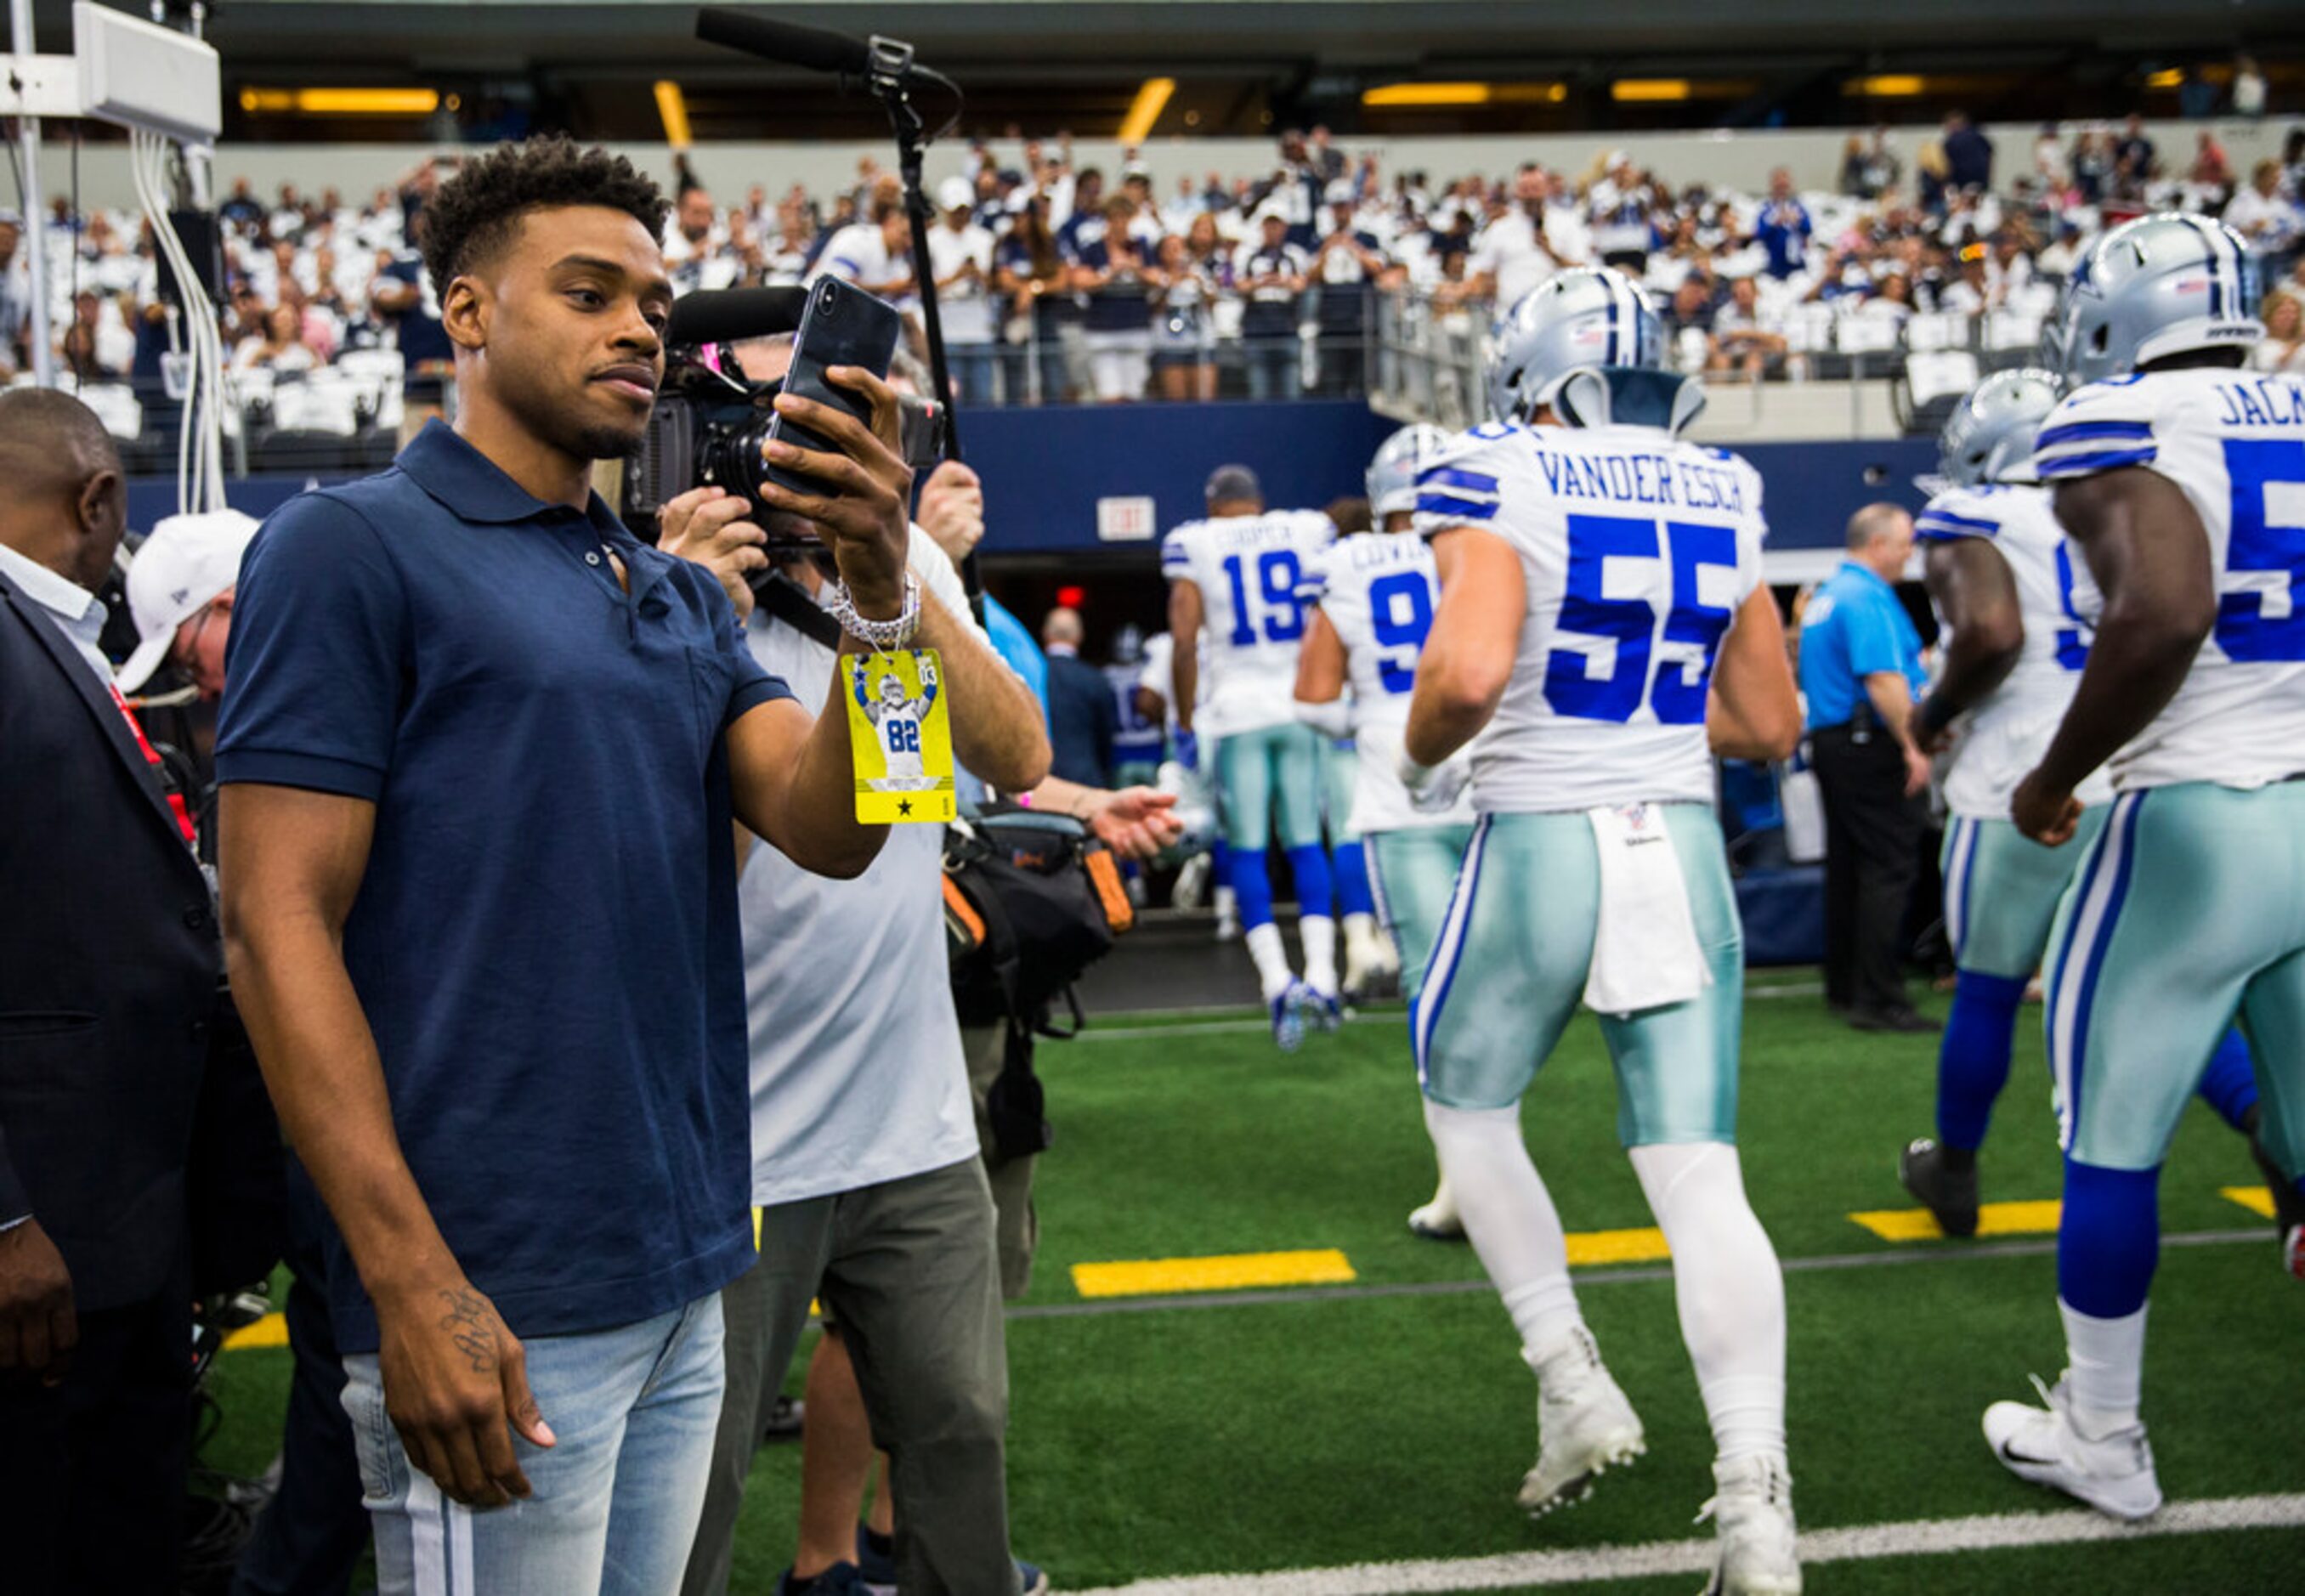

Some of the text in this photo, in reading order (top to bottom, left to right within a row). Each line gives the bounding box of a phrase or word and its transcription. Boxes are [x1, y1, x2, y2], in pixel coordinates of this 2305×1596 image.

[1537, 450, 1743, 516] VANDER ESCH
[1223, 550, 1303, 646] 19
[1368, 570, 1434, 694] 9
[1543, 514, 1736, 724] 55
[887, 721, 920, 752] 82
